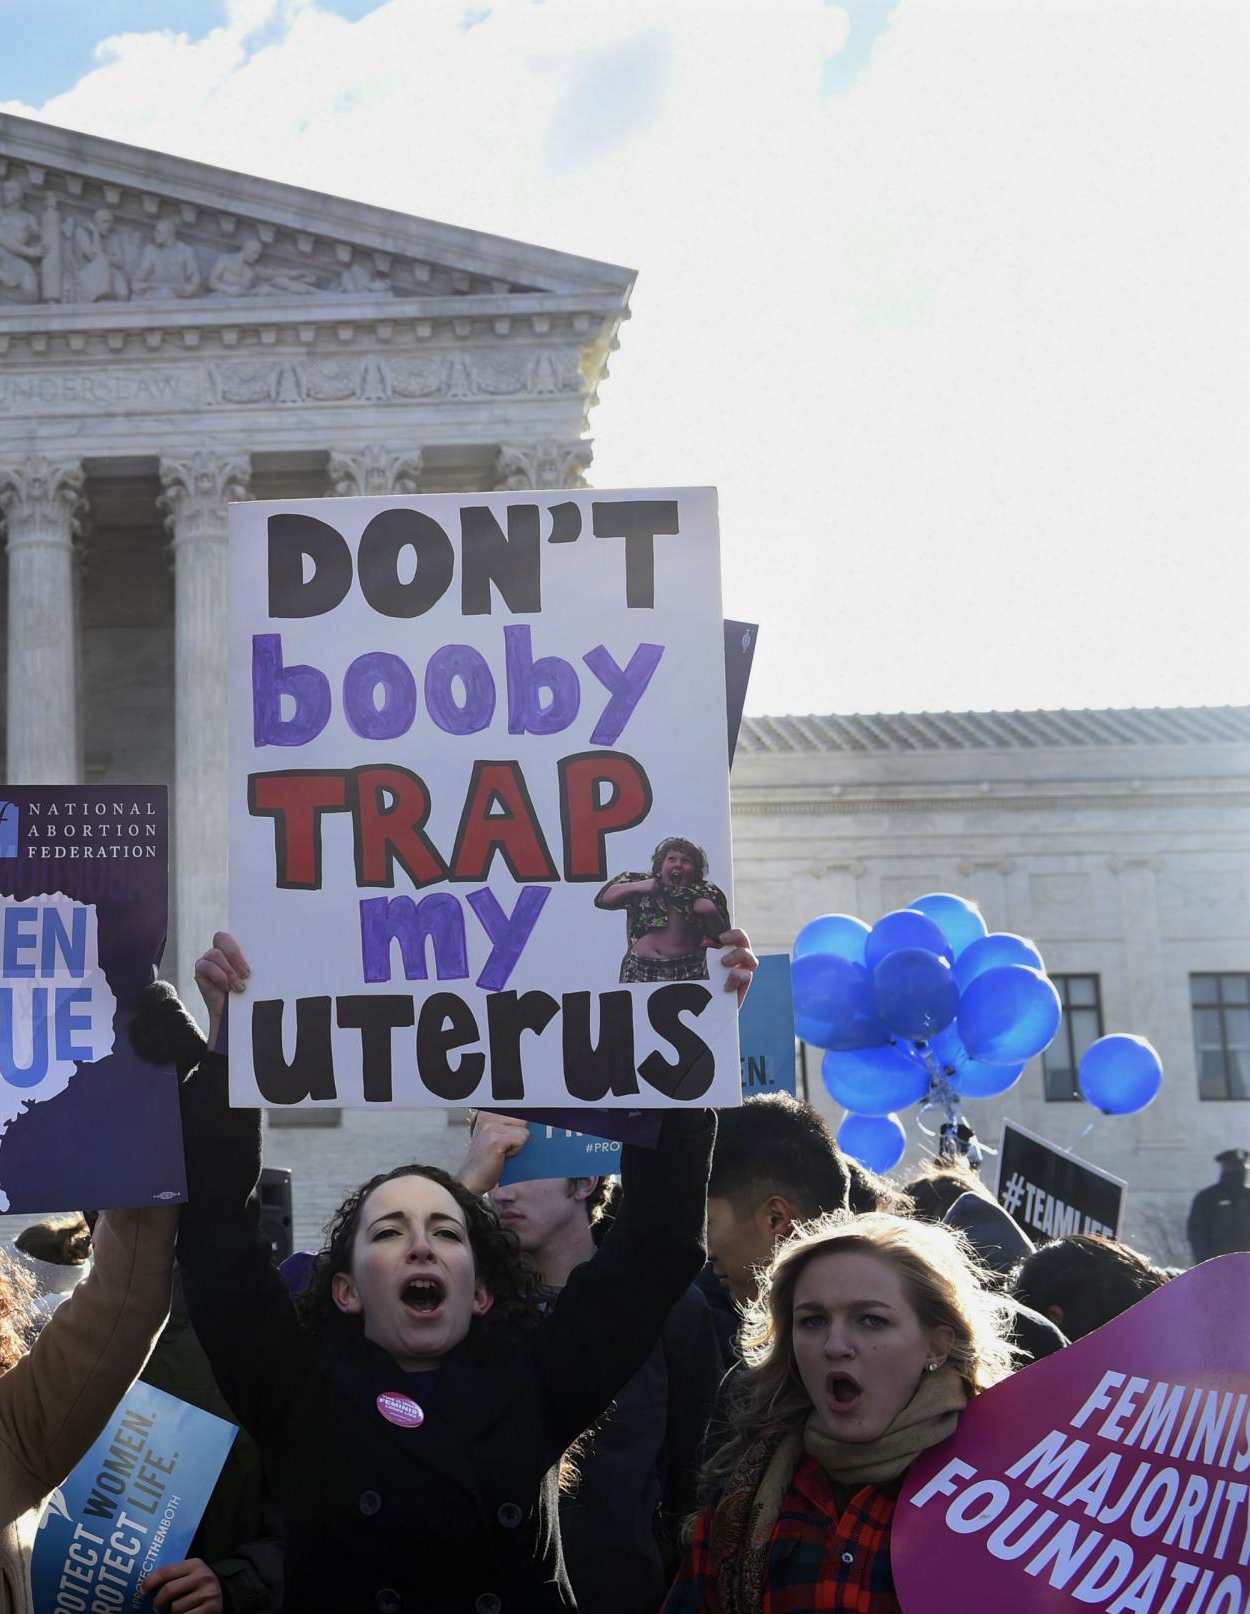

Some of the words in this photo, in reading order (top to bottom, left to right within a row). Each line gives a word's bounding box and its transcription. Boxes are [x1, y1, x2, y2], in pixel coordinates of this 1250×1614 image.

[268, 501, 680, 619] DON'T
[253, 625, 665, 748] booby
[27, 824, 157, 837] ABORTION
[27, 846, 157, 859] FEDERATION
[29, 803, 156, 816] NATIONAL
[248, 750, 653, 891] TRAP
[360, 886, 552, 992] my
[1002, 1172, 1114, 1240] #TEAMLI
[83, 1410, 159, 1520] WOMEN.
[125, 1451, 180, 1515] LIFE.
